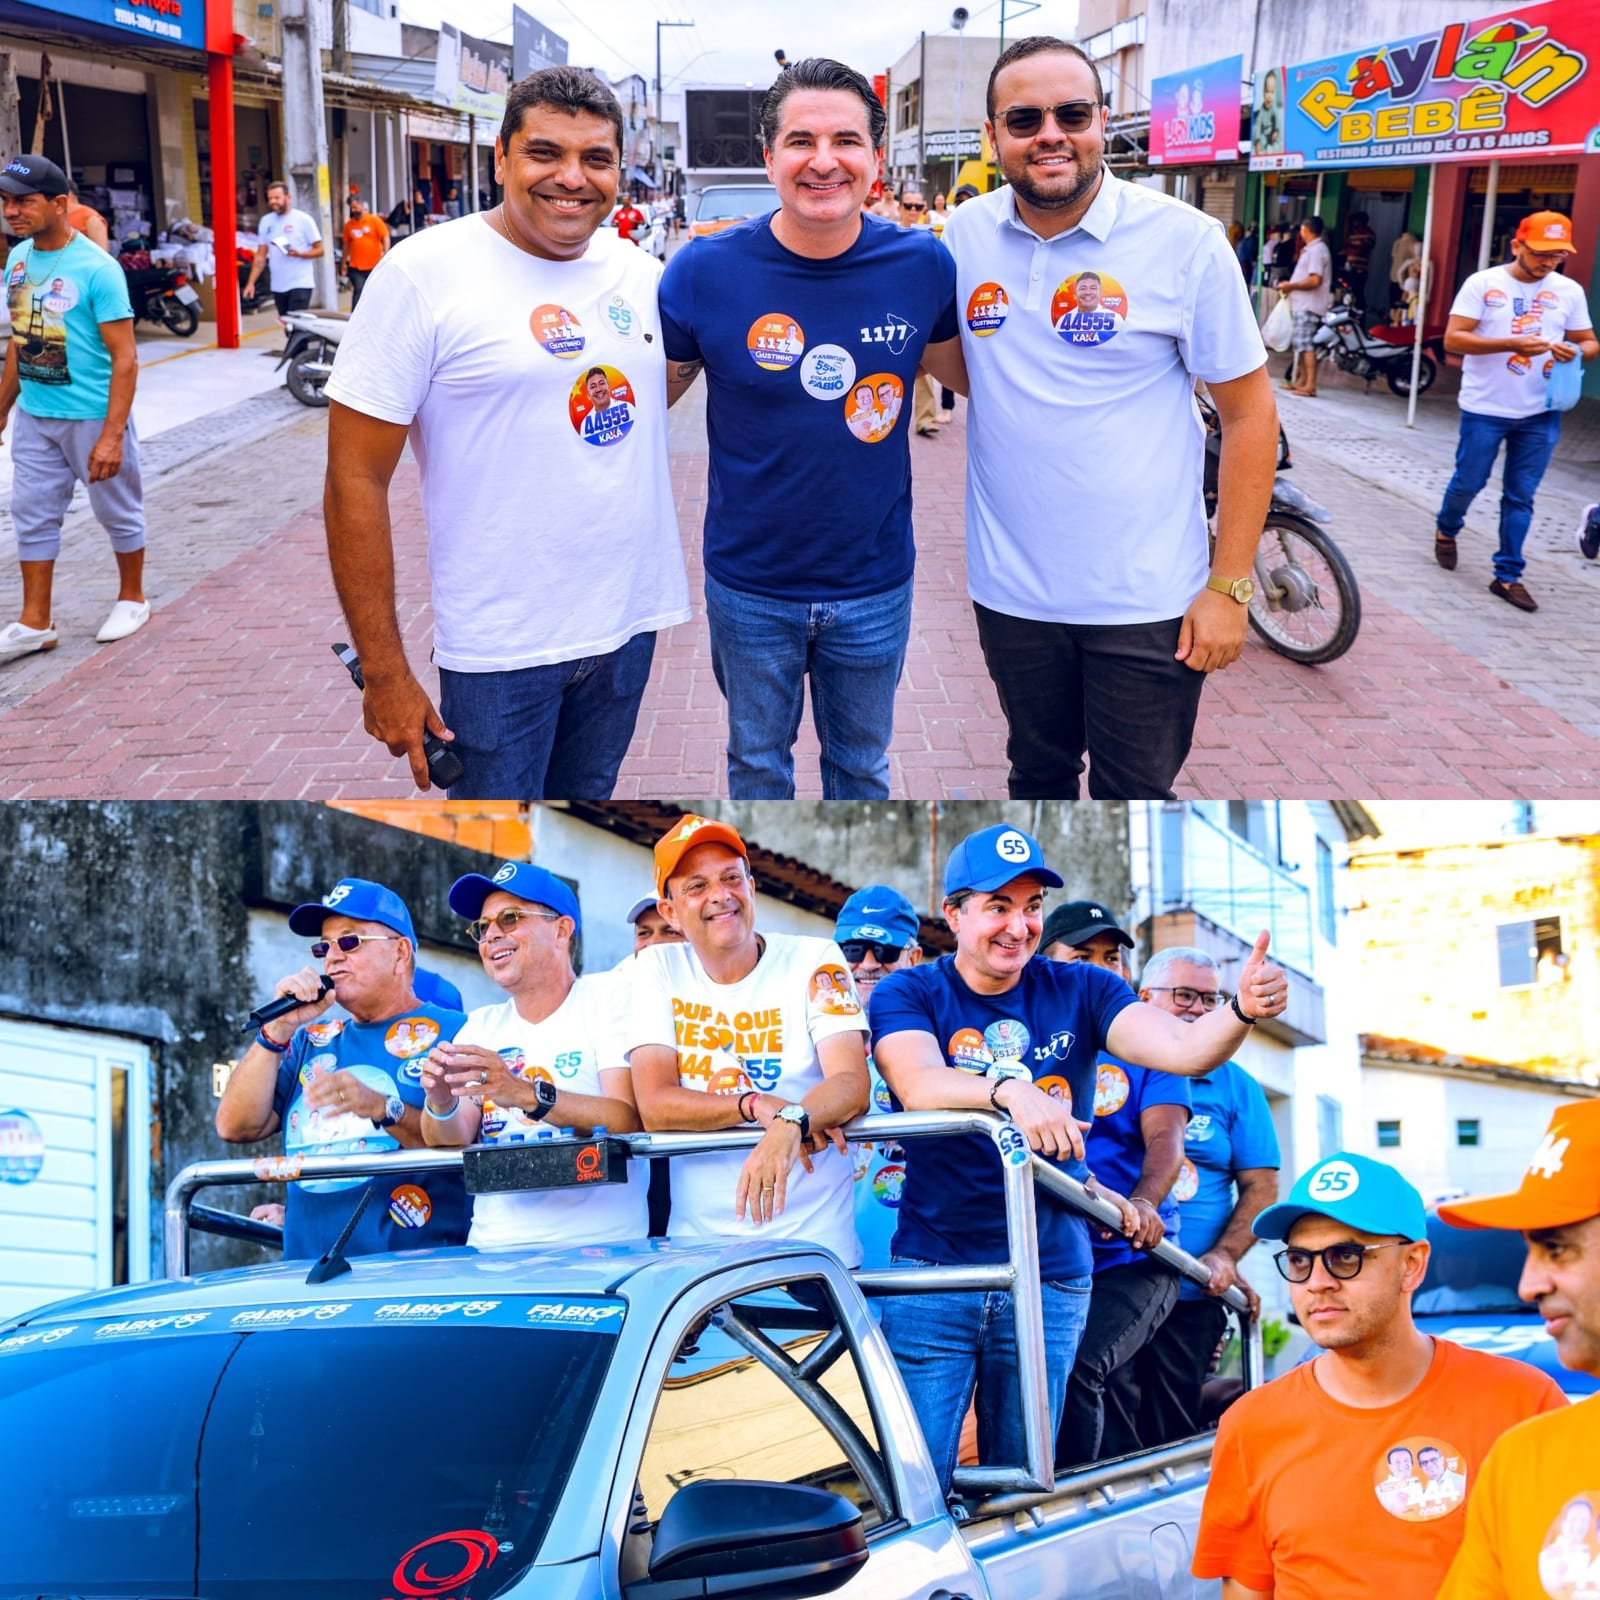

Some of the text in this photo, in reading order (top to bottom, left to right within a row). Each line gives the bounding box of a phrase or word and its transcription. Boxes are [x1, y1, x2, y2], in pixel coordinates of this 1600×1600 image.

[1339, 87, 1505, 143] BEBÊ
[1317, 149, 1369, 160] VESTINDO
[1371, 145, 1393, 157] SEU
[1394, 141, 1432, 155] FILHO
[1434, 139, 1453, 152] DE
[1468, 137, 1482, 150] A
[1484, 135, 1496, 148] 8
[1499, 131, 1549, 147] ANOS
[608, 305, 632, 323] 55
[1060, 312, 1116, 331] 44555
[860, 324, 908, 343] 1177
[584, 402, 630, 435] 44555
[1003, 839, 1026, 855] 55
[733, 1007, 782, 1031] QUE
[1033, 1034, 1070, 1061] 1177
[555, 1051, 582, 1069] 55
[745, 1058, 782, 1081] 55
[1000, 1132, 1024, 1156] 55
[1315, 1171, 1351, 1192] 55
[317, 1304, 352, 1316] 55
[464, 1301, 501, 1313] 55
